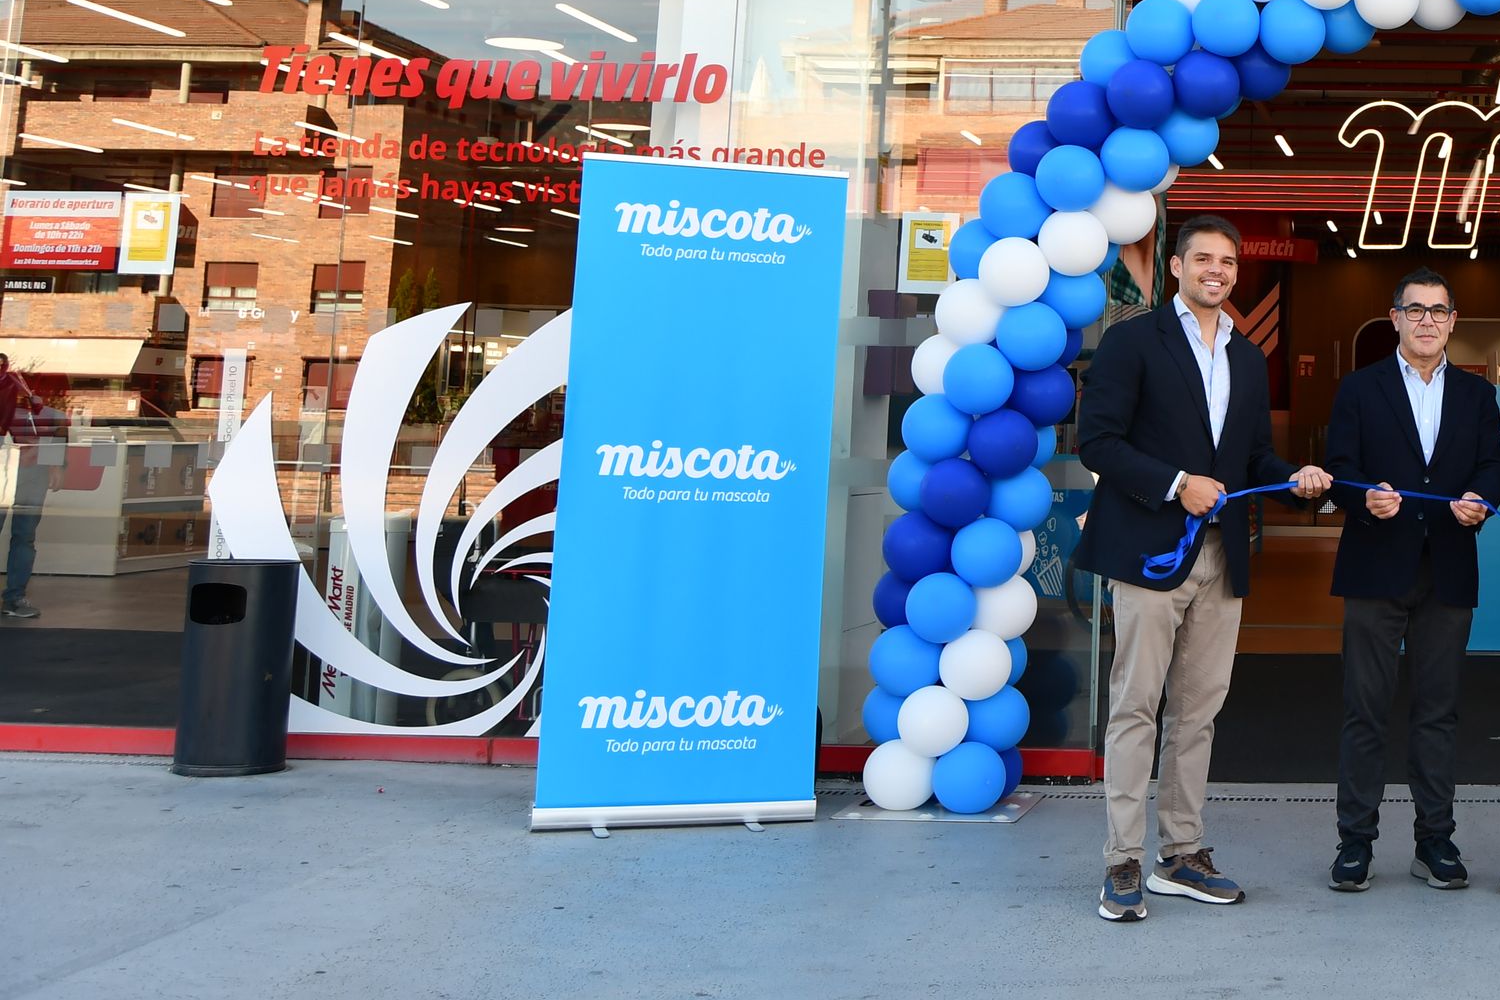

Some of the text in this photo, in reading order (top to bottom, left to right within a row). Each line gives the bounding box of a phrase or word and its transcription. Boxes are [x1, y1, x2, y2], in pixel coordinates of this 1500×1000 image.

[259, 43, 729, 109] Tienes que vivirlo
[253, 130, 288, 157] La
[300, 131, 401, 160] tienda
[408, 133, 447, 161] de
[712, 142, 826, 168] grande
[11, 198, 114, 211] Horario de apertura
[249, 170, 582, 207] que jamás hayas vist
[614, 200, 810, 244] miscota
[13, 244, 54, 255] Domingos
[55, 244, 66, 253] de
[639, 243, 786, 265] Todo para tu mascota
[223, 366, 238, 443] Google Pixel 10
[595, 440, 794, 480] miscota
[622, 486, 770, 503] Todo para tu mascota
[215, 528, 225, 558] oogle
[345, 585, 355, 620] MADRID
[577, 689, 780, 729] miscota
[605, 736, 757, 755] Todo para tu mascota
